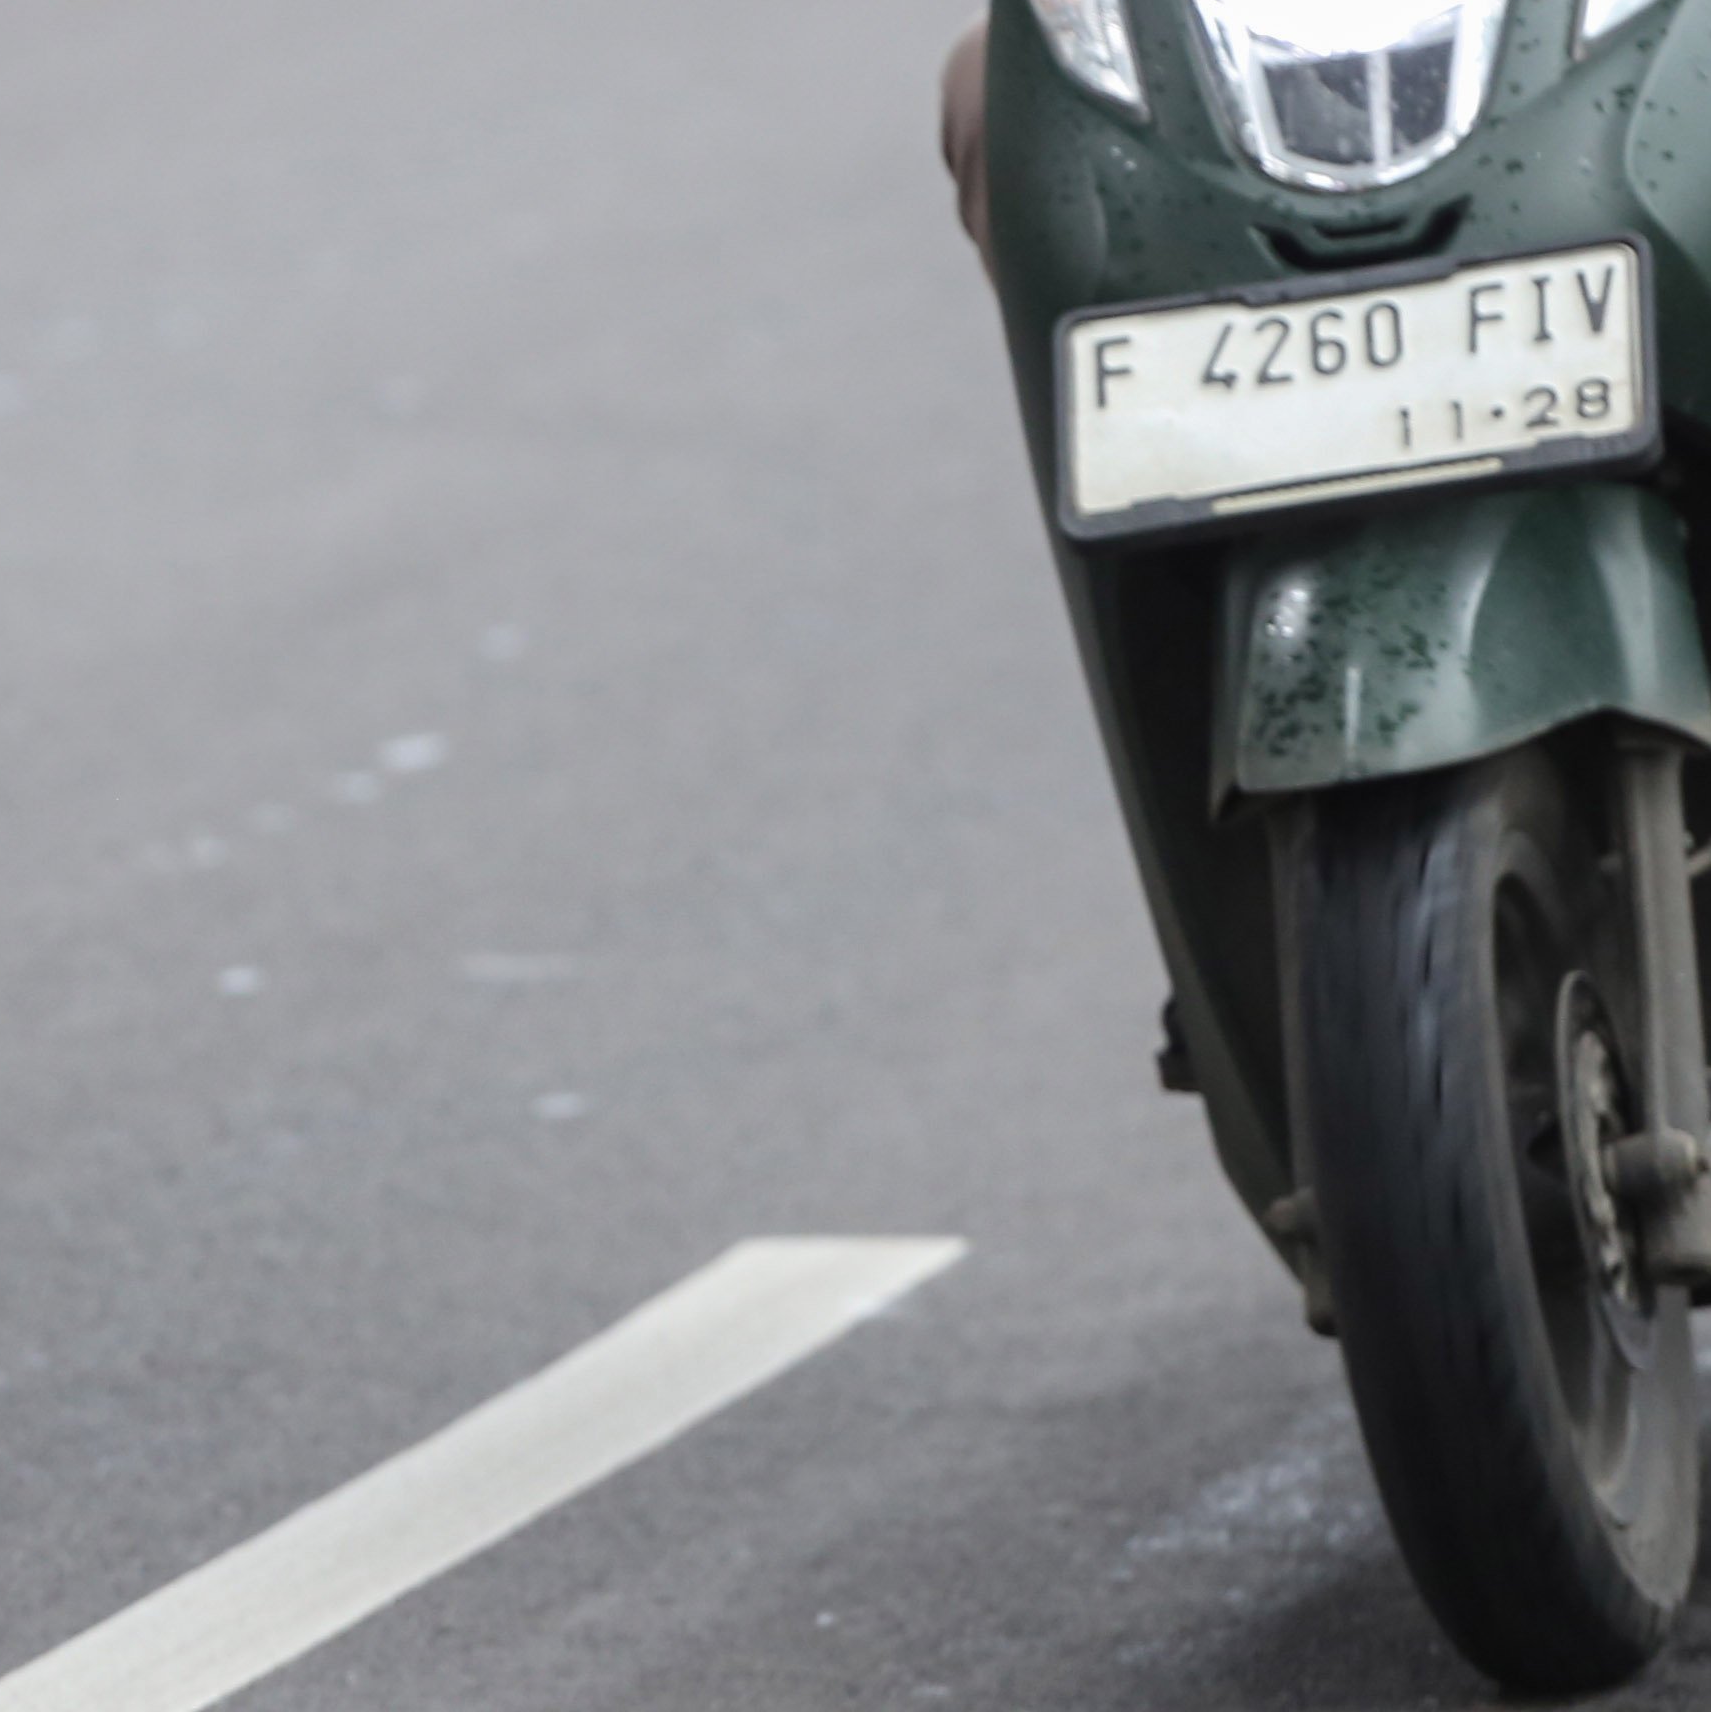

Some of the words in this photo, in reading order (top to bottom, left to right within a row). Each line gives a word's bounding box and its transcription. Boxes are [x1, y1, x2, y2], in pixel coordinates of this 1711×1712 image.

[1093, 335, 1132, 409] F
[1200, 302, 1405, 392] 4260
[1468, 264, 1615, 354] FIV
